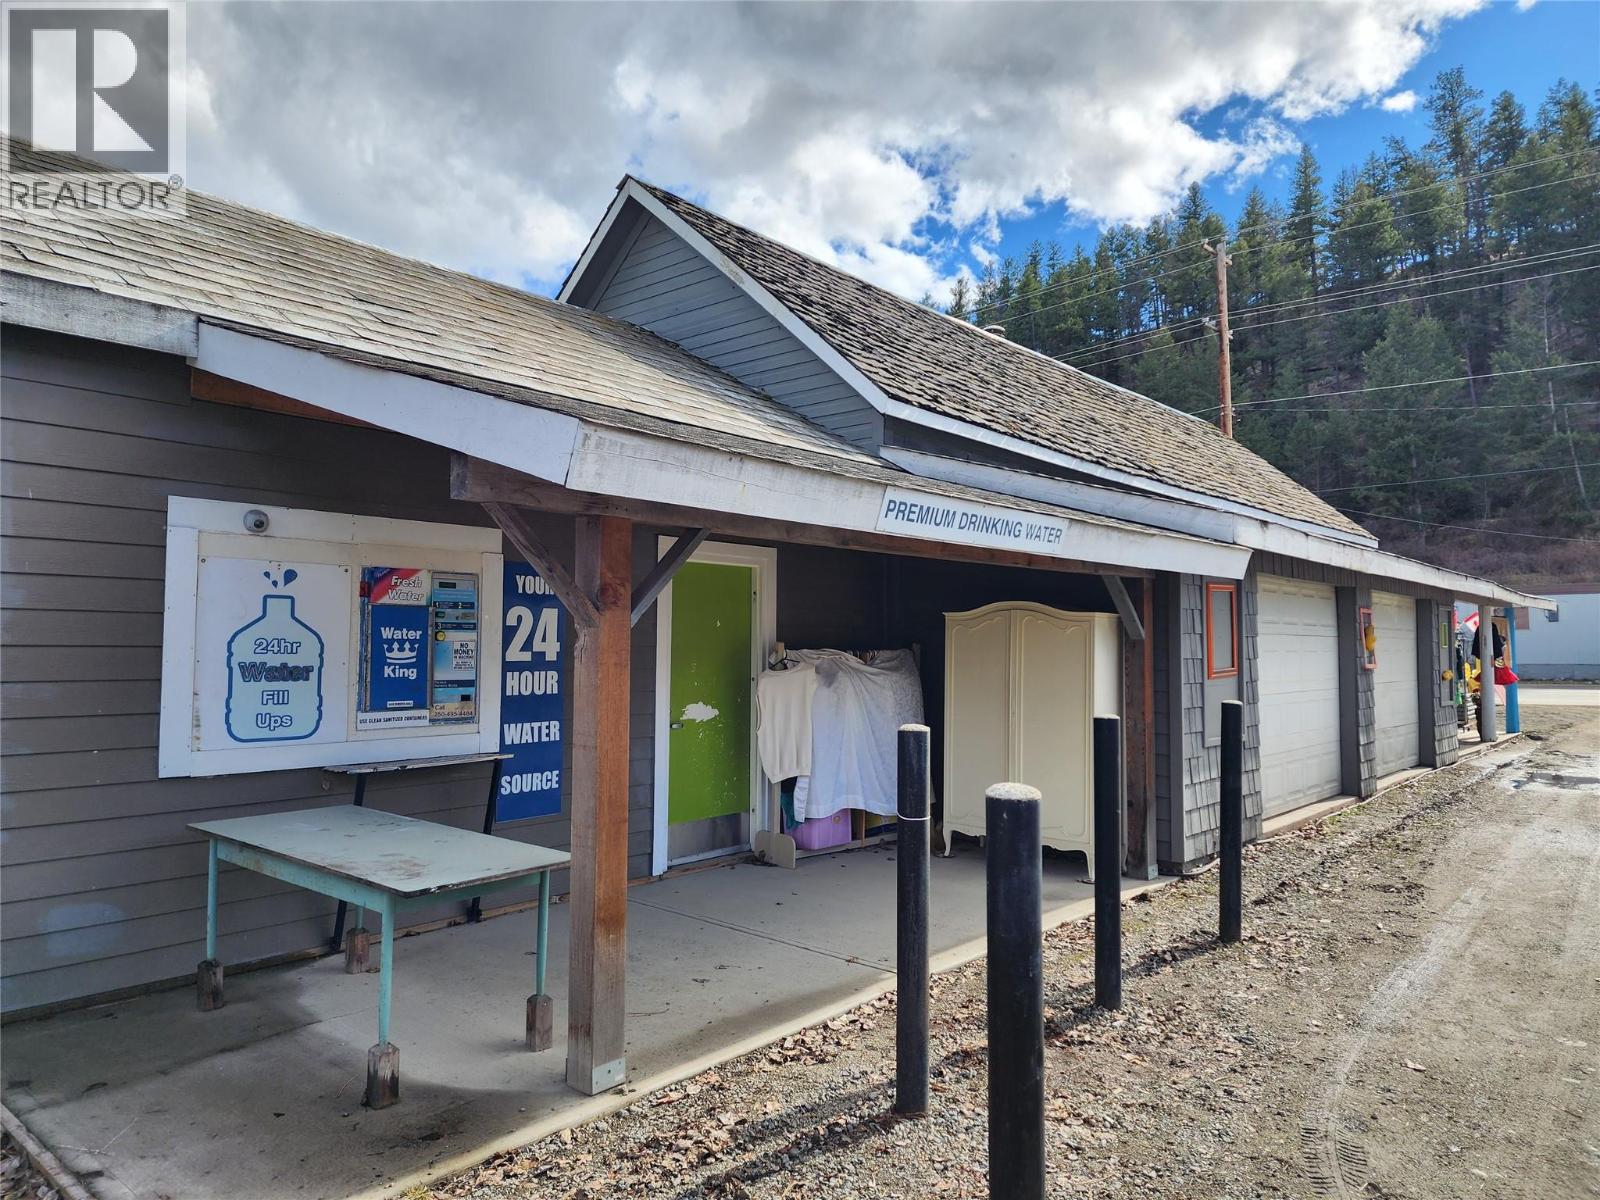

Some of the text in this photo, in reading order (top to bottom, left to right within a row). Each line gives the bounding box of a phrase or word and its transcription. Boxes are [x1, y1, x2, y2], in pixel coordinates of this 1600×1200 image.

[884, 499, 1063, 545] PREMIUM DRINKING WATER
[391, 576, 422, 588] Fresh
[387, 589, 424, 601] Water
[380, 626, 423, 640] Water
[505, 605, 561, 661] 24
[253, 637, 301, 655] 24hr
[238, 661, 314, 683] Water
[383, 665, 417, 680] King
[506, 670, 559, 696] HOUR
[261, 689, 290, 706] Fill
[256, 712, 293, 731] Ups
[503, 720, 560, 745] WATER
[500, 770, 560, 795] SOURCE
